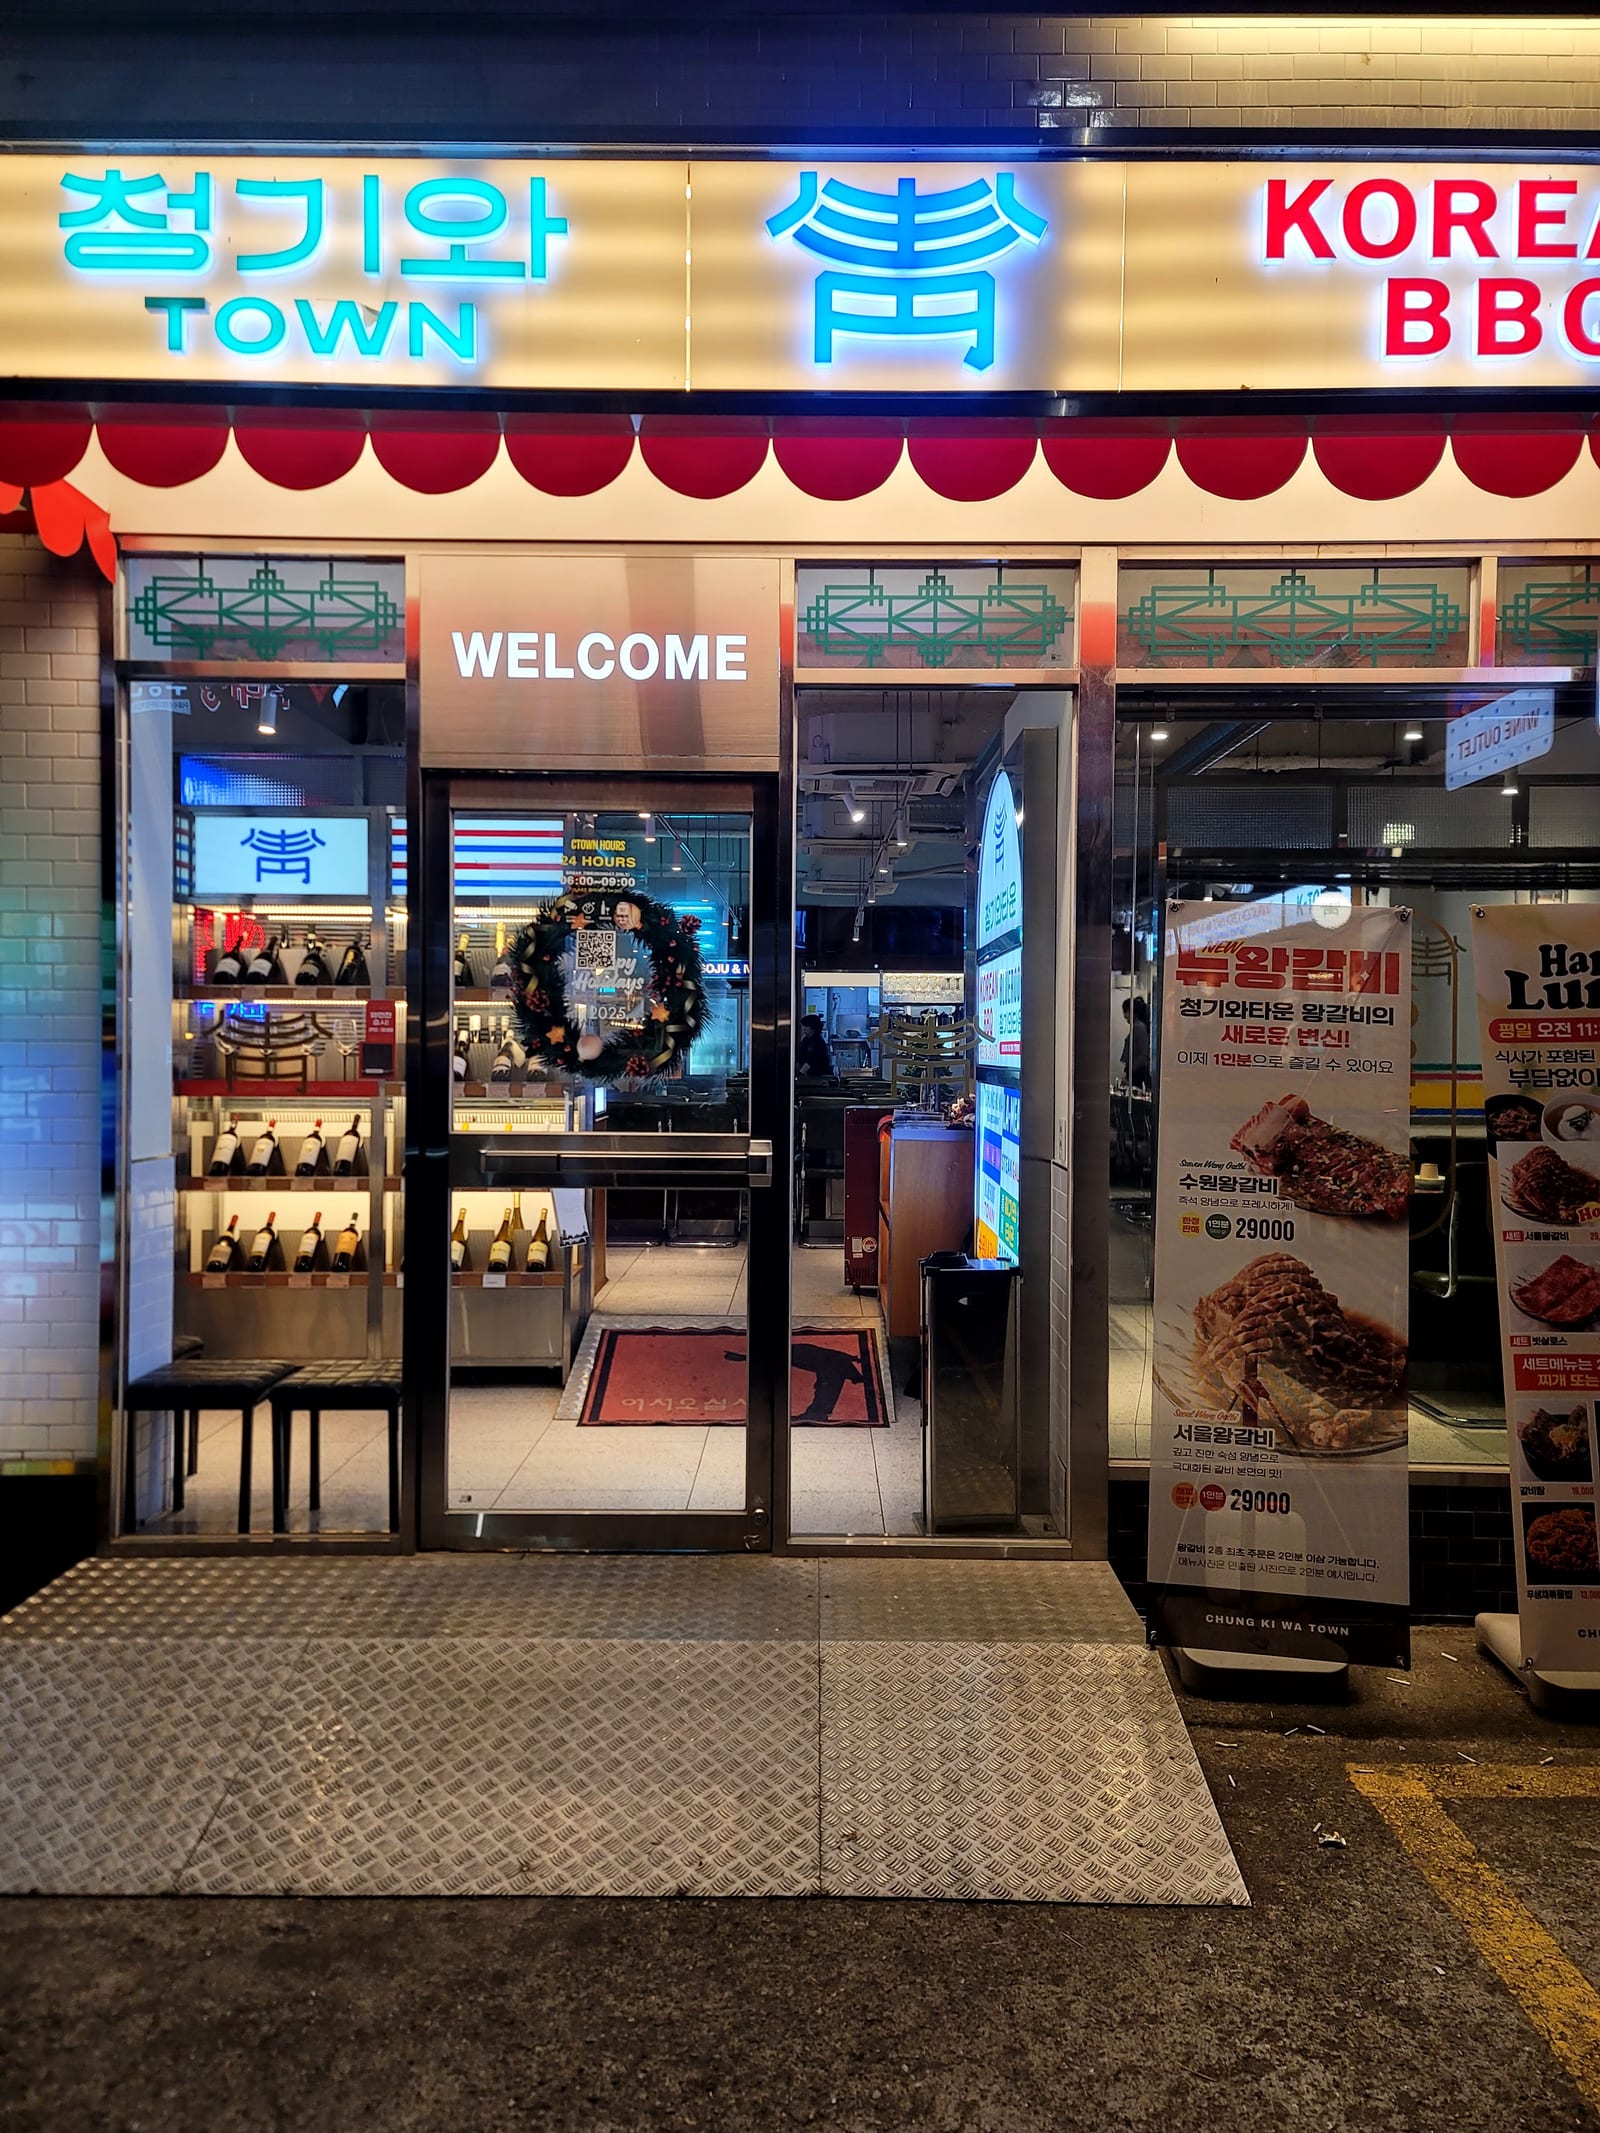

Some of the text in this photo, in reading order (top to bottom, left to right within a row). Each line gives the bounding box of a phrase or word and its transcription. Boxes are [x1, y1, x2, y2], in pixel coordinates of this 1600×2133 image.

[58, 169, 569, 281] 청기와
[145, 296, 479, 362] TOWN
[451, 632, 748, 682] WELCOME
[599, 840, 626, 851] HOURS
[561, 855, 637, 868] 24 HOURS
[1202, 940, 1244, 954] NEW
[1175, 943, 1400, 995] 뉴왕갈비
[1179, 998, 1394, 1026] 청기와타운 왕갈비의
[1221, 1025, 1350, 1048] 새로운 변신!
[1499, 1022, 1600, 1038] 평일 오전 11:
[1177, 1051, 1394, 1074] 이제 1인분으로 즐길 수 있어요
[1495, 1049, 1596, 1064] 식사가 포함된
[1179, 1173, 1278, 1195] 수원왕갈비
[1242, 1199, 1293, 1211] 프레시하게!
[1207, 1219, 1229, 1229] 1인분
[1235, 1217, 1295, 1241] 29000
[1505, 1231, 1522, 1241] 세트
[1512, 1336, 1529, 1346] 세트
[1522, 1357, 1593, 1371] 세트메뉴는
[1537, 1374, 1600, 1387] 찌개 또는
[1173, 1424, 1274, 1448] 서울왕갈비
[1195, 1448, 1215, 1459] 진한
[1214, 1465, 1234, 1475] 갈비
[1230, 1488, 1291, 1514] 29000
[1226, 1547, 1246, 1557] 최초
[1247, 1548, 1275, 1560] 주문은
[1278, 1551, 1304, 1562] 2인분
[1306, 1554, 1326, 1564] 이상
[1327, 1555, 1380, 1569] 가능합니다.
[1258, 1563, 1297, 1576] 사진으로
[1205, 1613, 1350, 1636] CHUNG KI WA TOWN
[1577, 1628, 1600, 1638] CH
